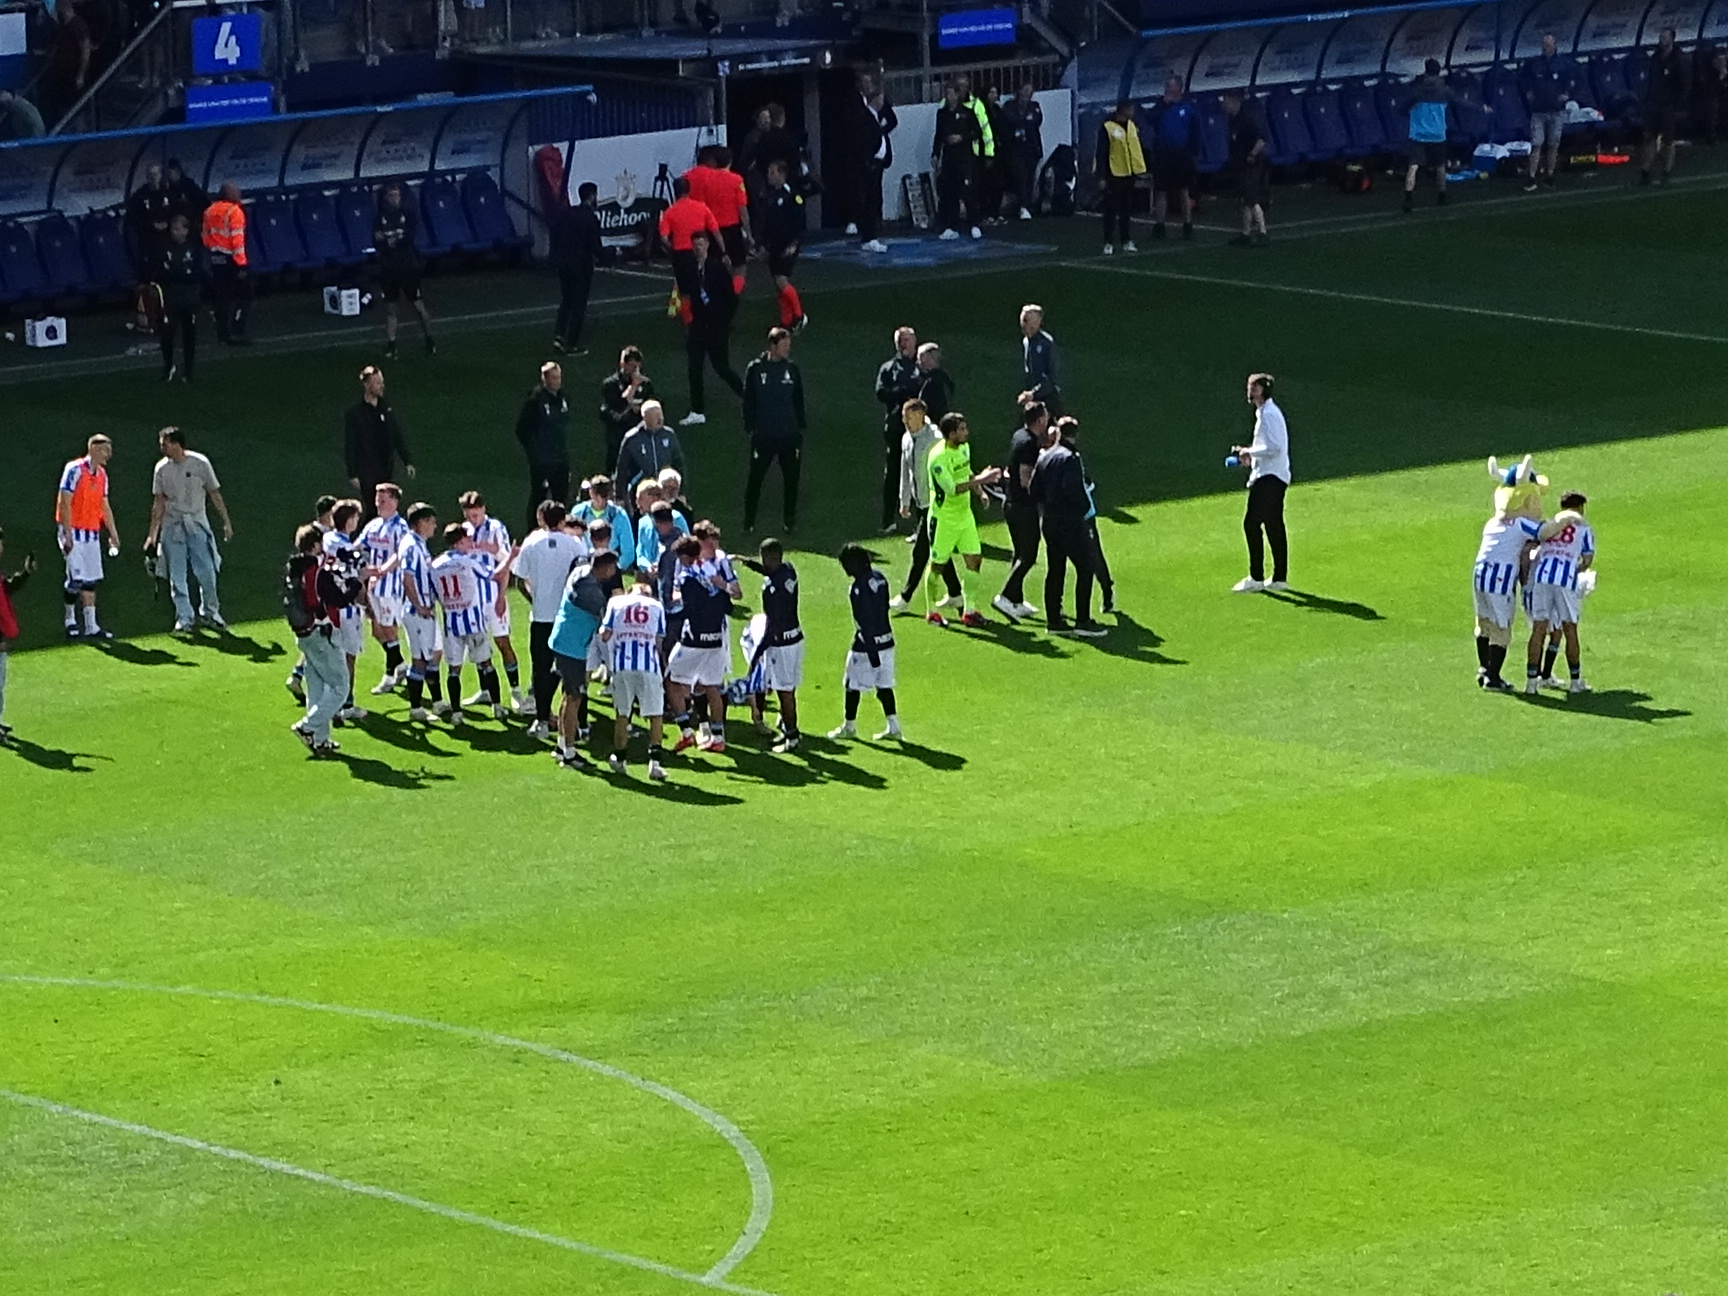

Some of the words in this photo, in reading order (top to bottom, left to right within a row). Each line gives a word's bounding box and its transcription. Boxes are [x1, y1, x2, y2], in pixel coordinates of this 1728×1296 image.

[213, 21, 241, 65] 4
[439, 574, 462, 600] 11
[623, 604, 650, 624] 16
